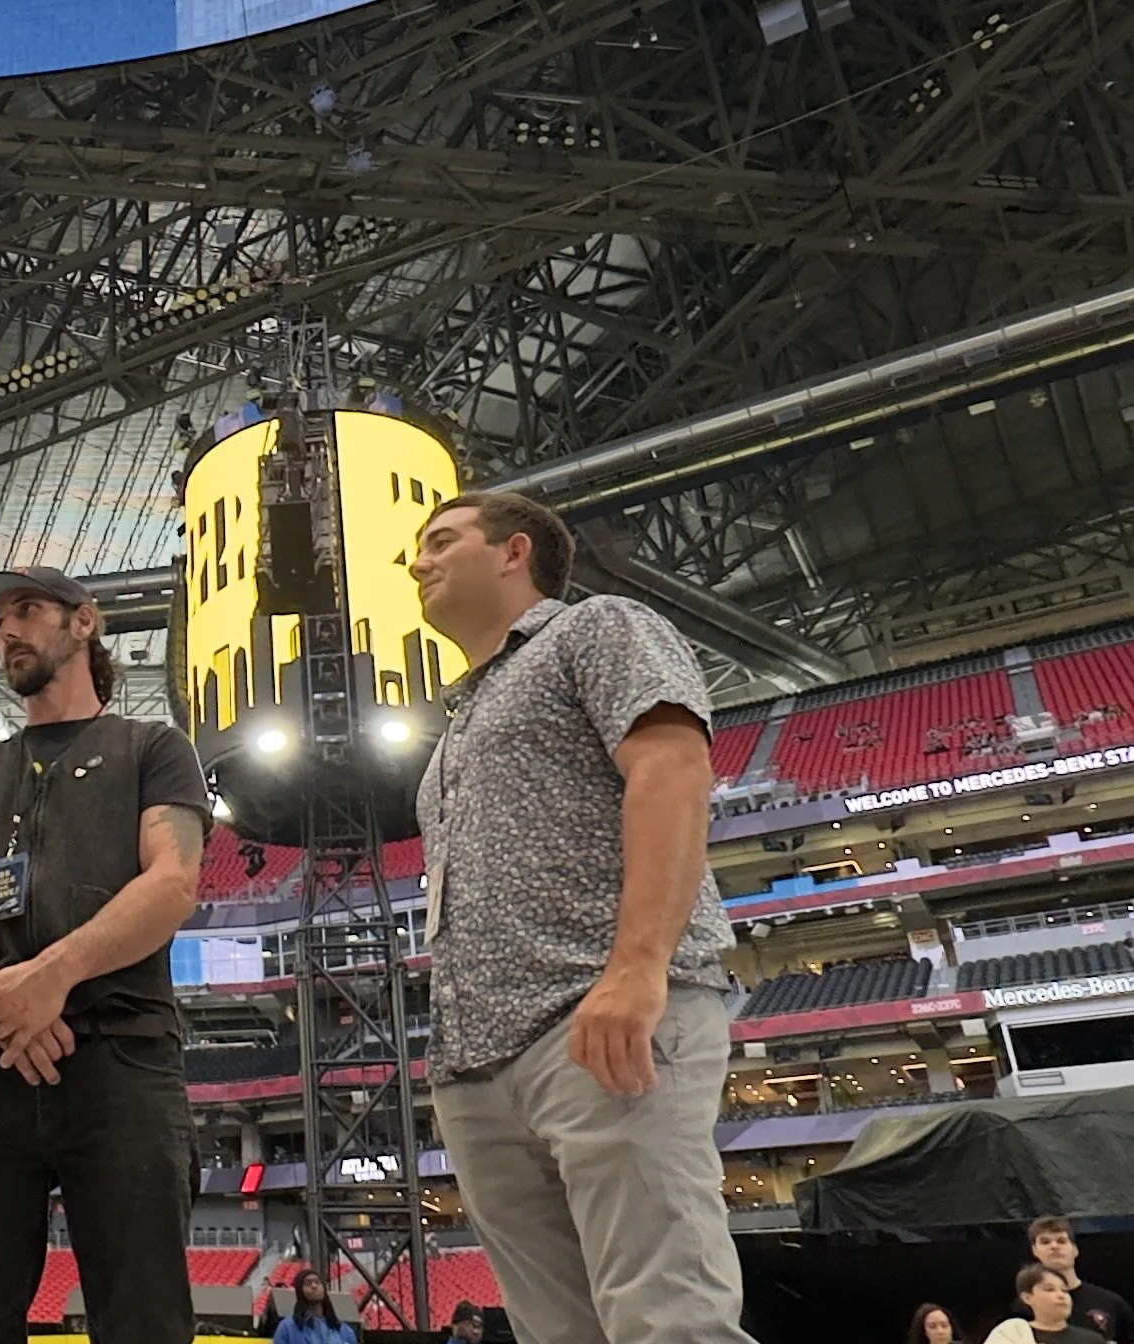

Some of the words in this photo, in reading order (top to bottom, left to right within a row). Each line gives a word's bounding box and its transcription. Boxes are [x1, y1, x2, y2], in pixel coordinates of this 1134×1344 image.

[845, 785, 929, 813] WELCOME
[930, 780, 953, 798] TO
[953, 752, 1105, 795] MERCEDES-BENZ
